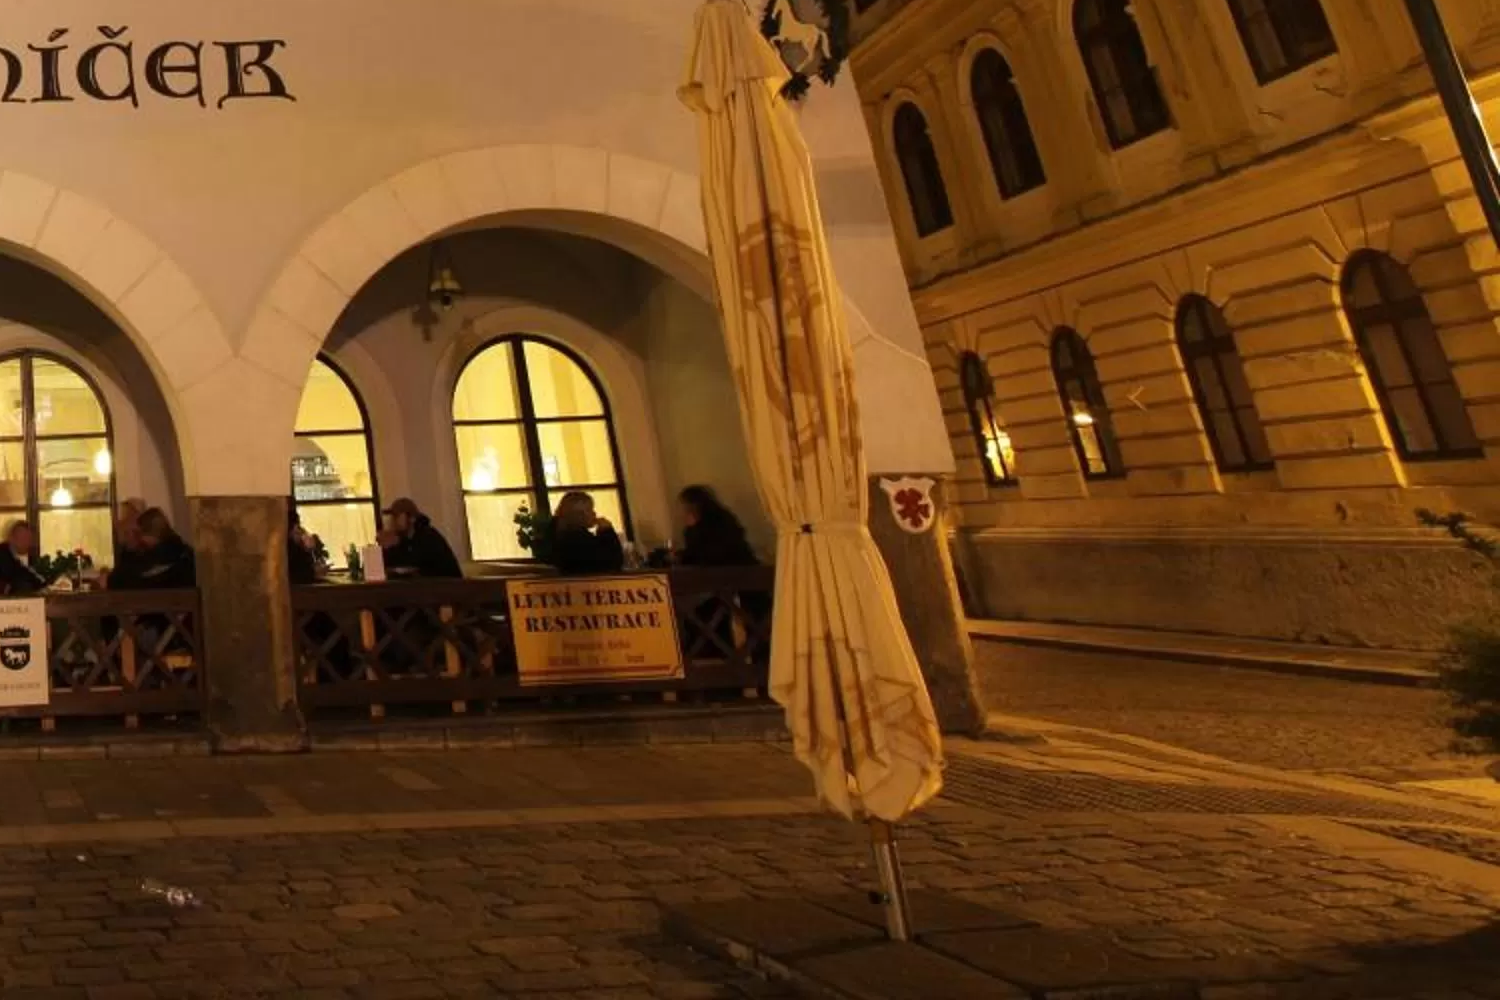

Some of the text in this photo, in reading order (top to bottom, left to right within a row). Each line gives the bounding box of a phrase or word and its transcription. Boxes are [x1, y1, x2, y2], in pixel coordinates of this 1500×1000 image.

[513, 584, 665, 609] LETNÍ TERASA
[525, 611, 661, 632] RESTAURACE
